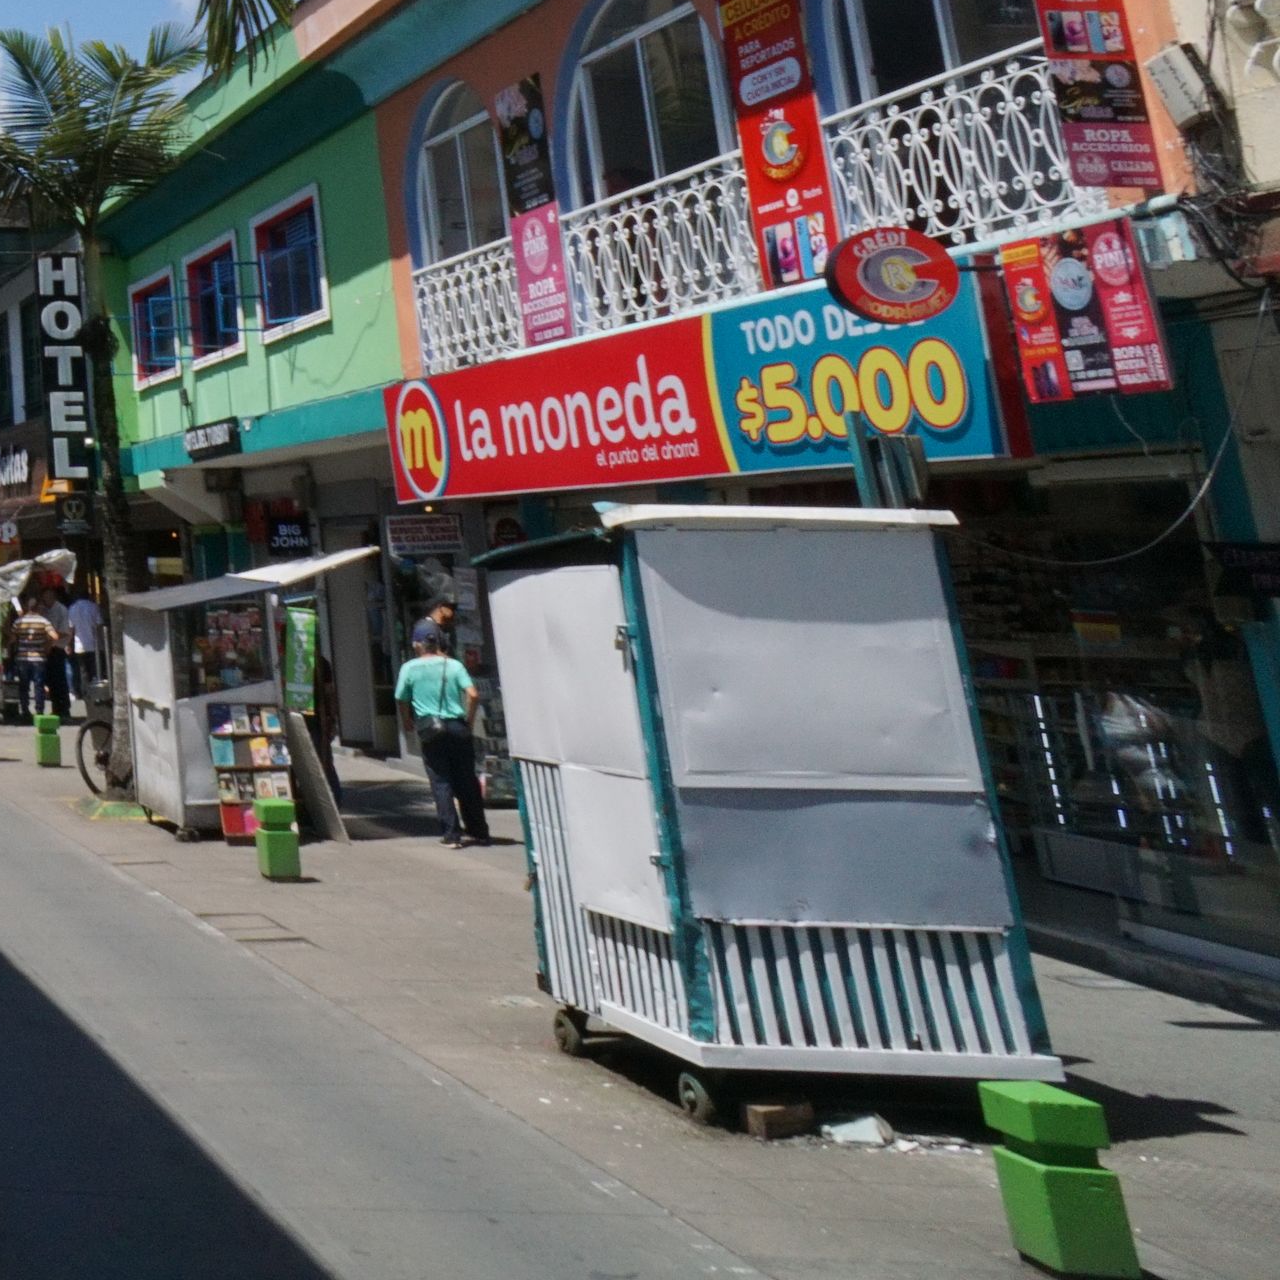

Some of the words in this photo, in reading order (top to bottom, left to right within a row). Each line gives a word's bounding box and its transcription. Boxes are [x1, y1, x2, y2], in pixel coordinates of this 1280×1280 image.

[1083, 128, 1134, 143] ROPA
[853, 228, 907, 258] CRÉDI
[528, 277, 557, 300] ROPA
[740, 308, 816, 355] TODO
[37, 256, 90, 479] HOTEL
[736, 337, 968, 446] $5.000
[454, 398, 498, 463] la
[503, 354, 697, 458] moneda
[609, 444, 639, 469] punto
[641, 439, 660, 463] del
[271, 535, 310, 548] JOHN
[277, 524, 301, 536] BIG
